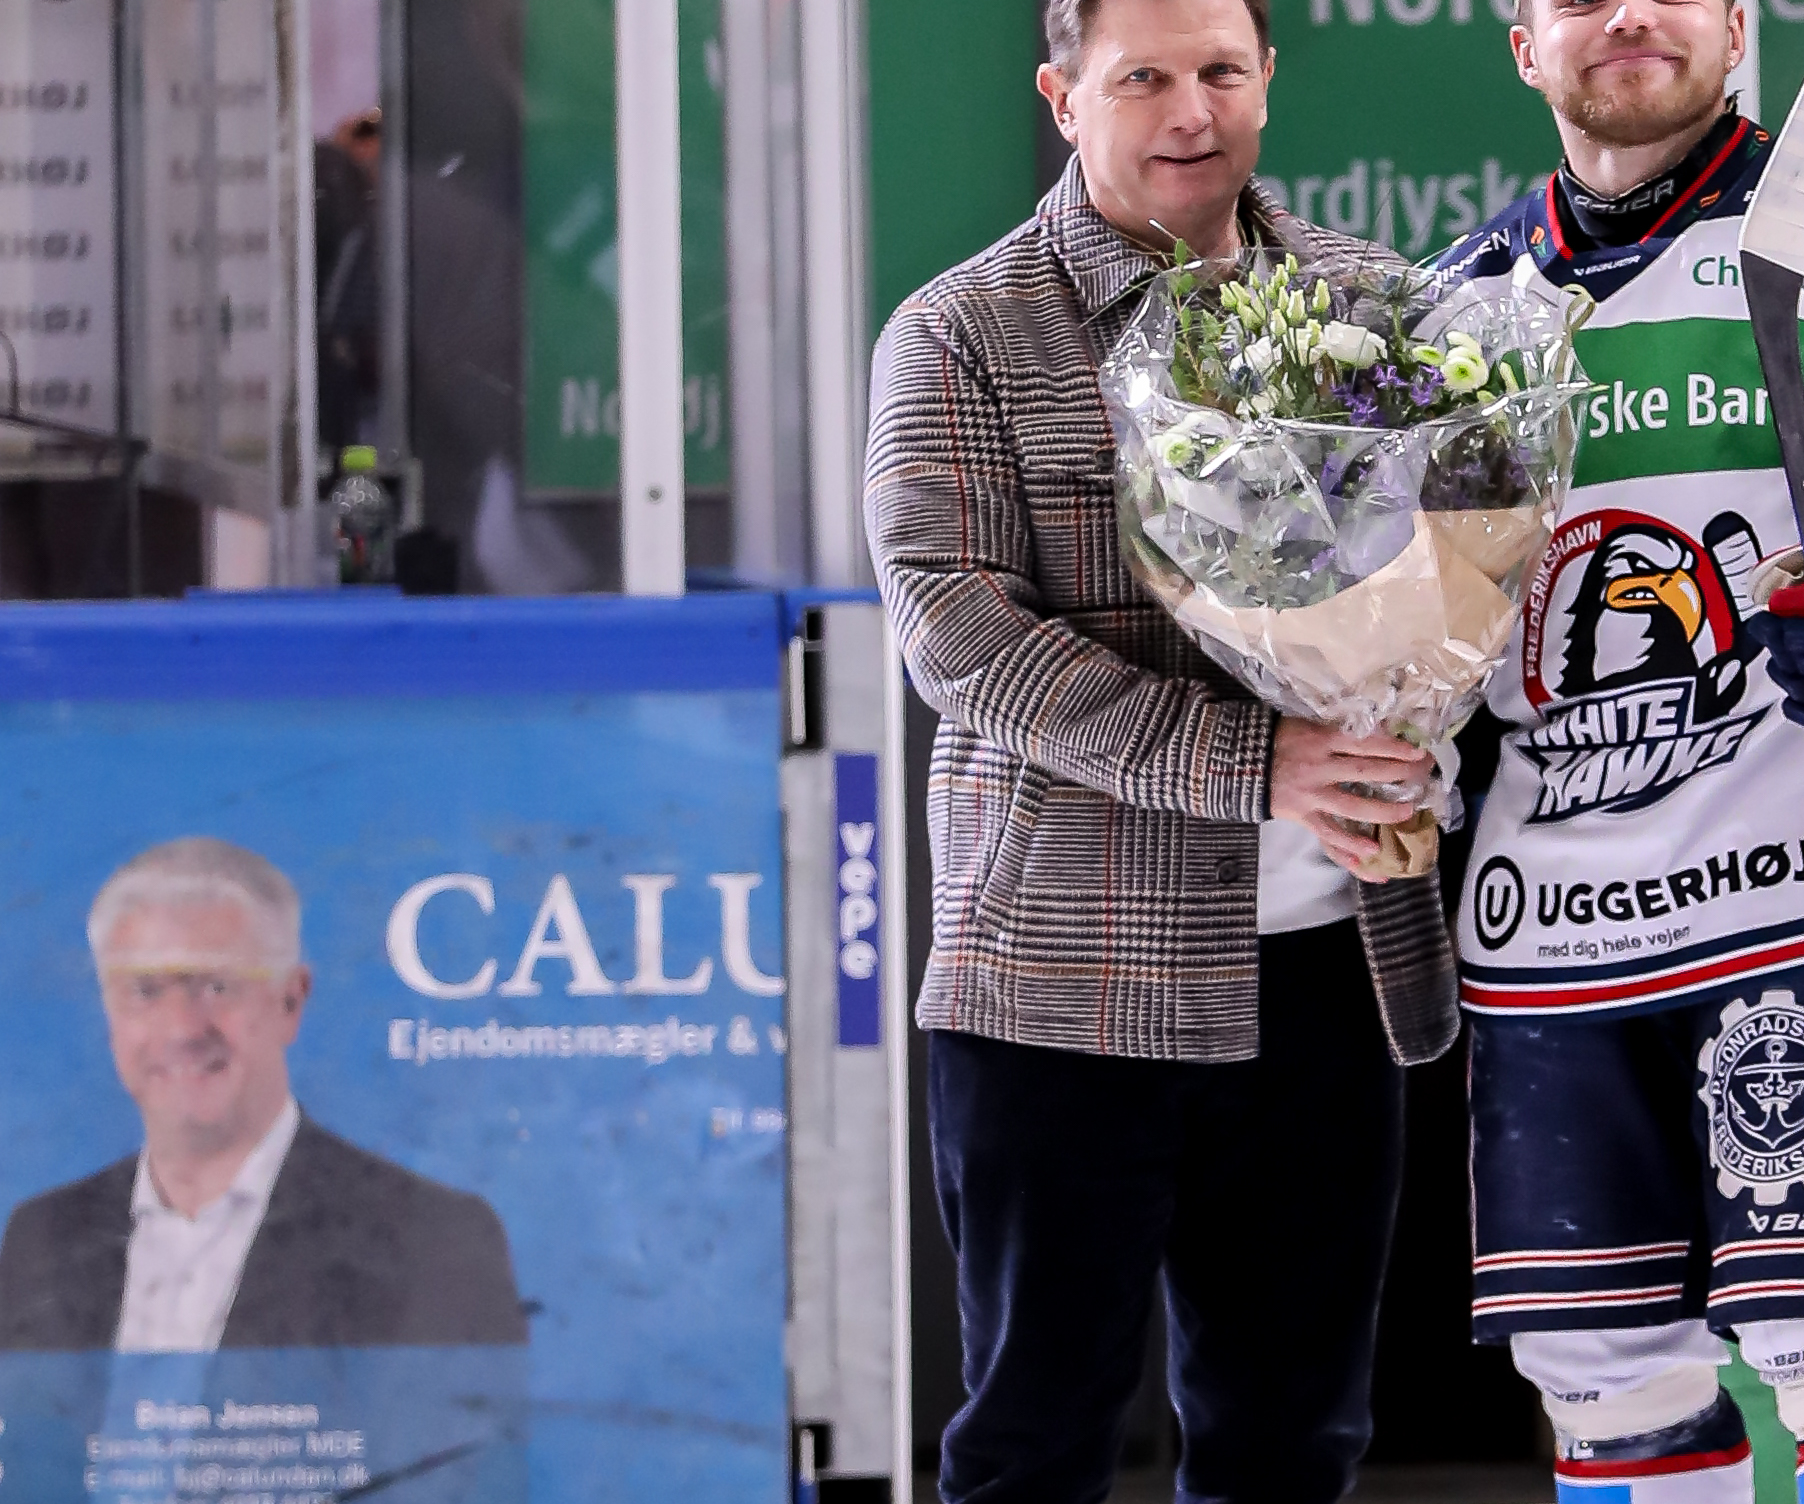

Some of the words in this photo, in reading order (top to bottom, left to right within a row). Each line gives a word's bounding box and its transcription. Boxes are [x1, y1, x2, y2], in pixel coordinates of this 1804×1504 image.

[1524, 518, 1604, 681] FREDERIKSHAVN
[1530, 685, 1686, 749] WHITE
[1536, 717, 1754, 819] HAWKS
[1573, 938, 1600, 959] dig
[388, 1017, 719, 1065] Ejendomsmægler
[726, 1014, 759, 1056] &
